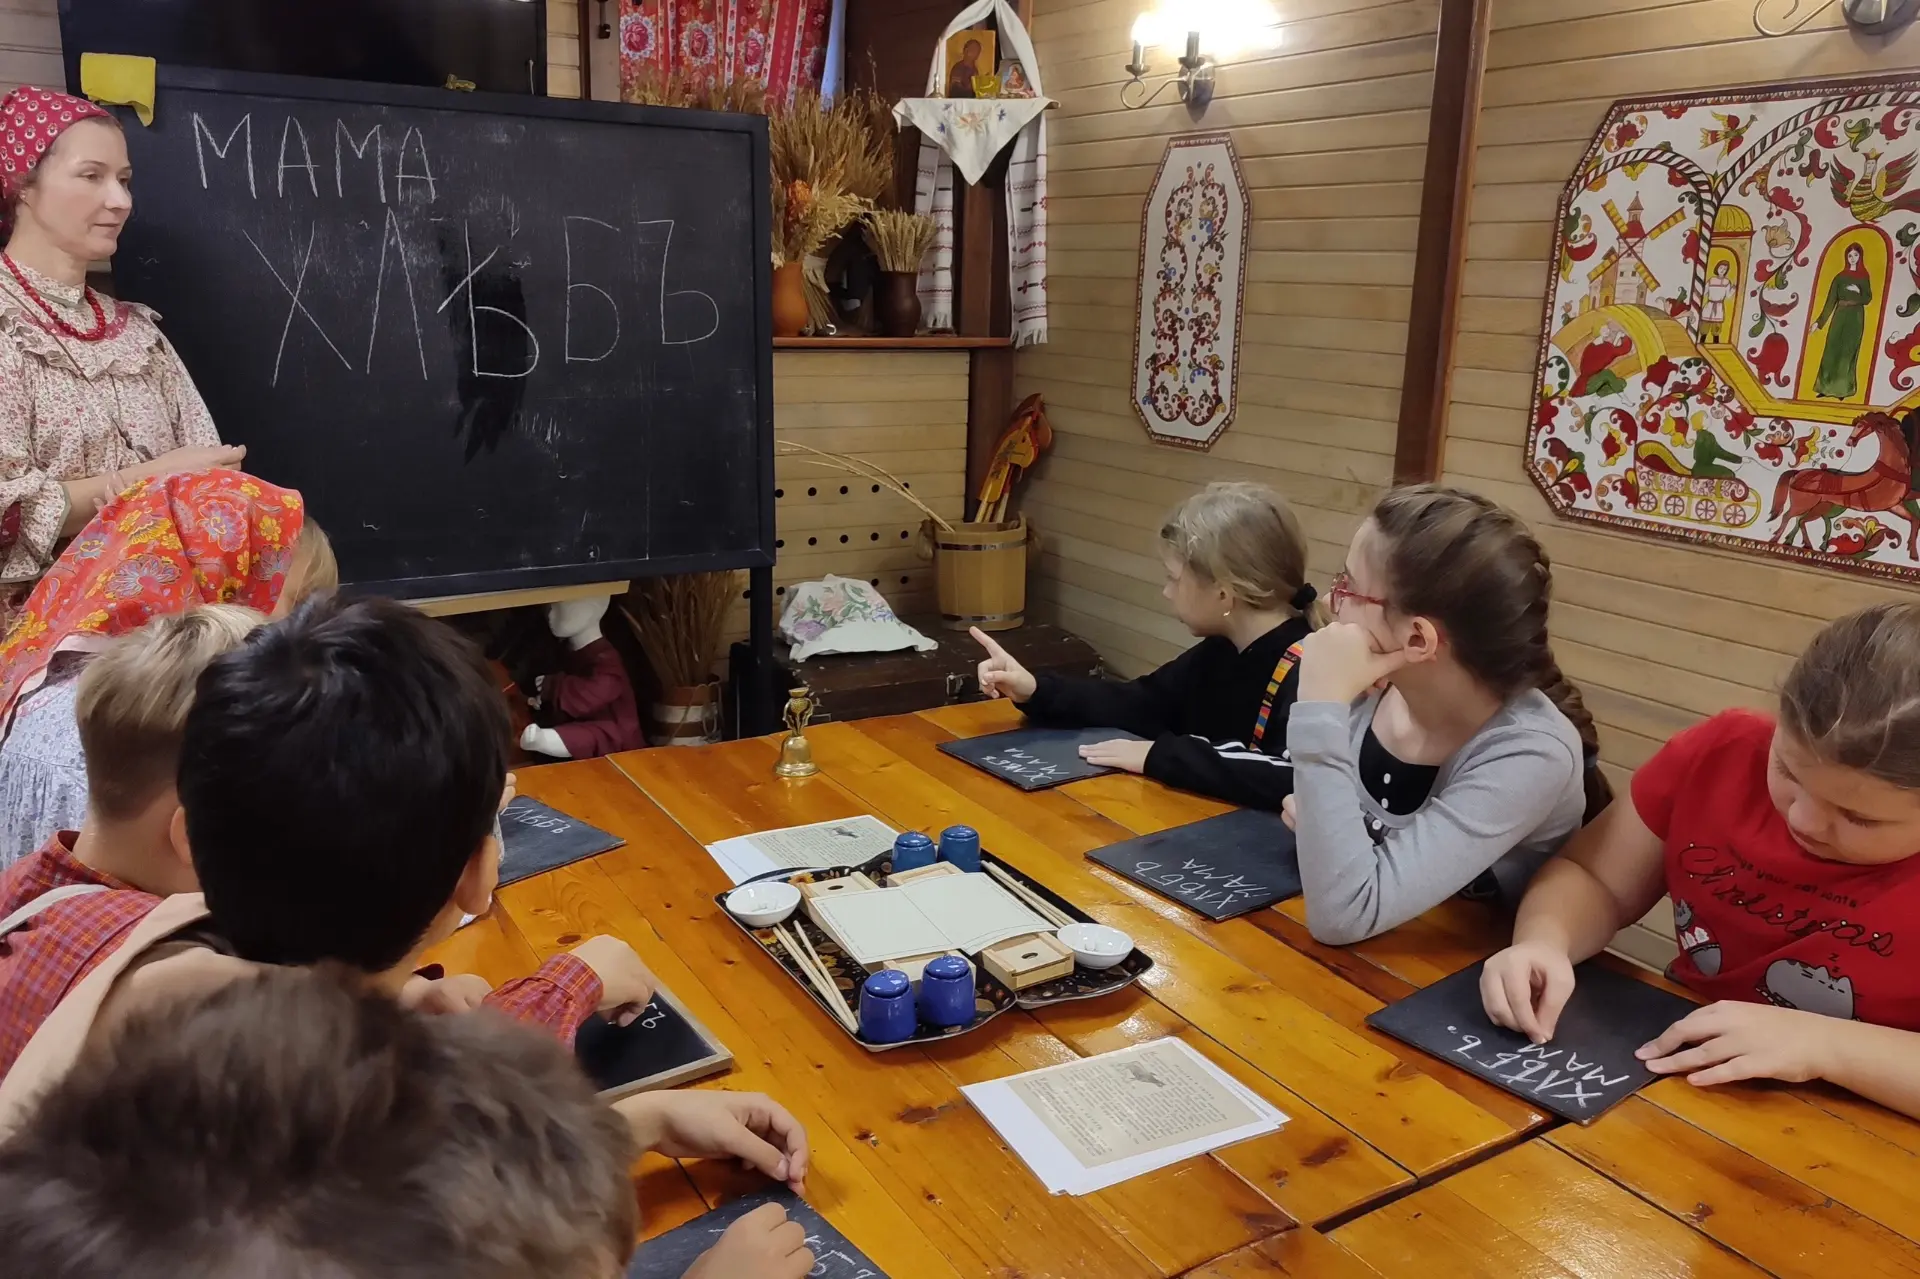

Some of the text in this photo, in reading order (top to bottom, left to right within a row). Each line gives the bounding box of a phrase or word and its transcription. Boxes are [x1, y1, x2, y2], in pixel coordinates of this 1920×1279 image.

[193, 112, 437, 204] МАМА
[1003, 747, 1070, 775] МАМА
[1181, 858, 1271, 898] МАМА
